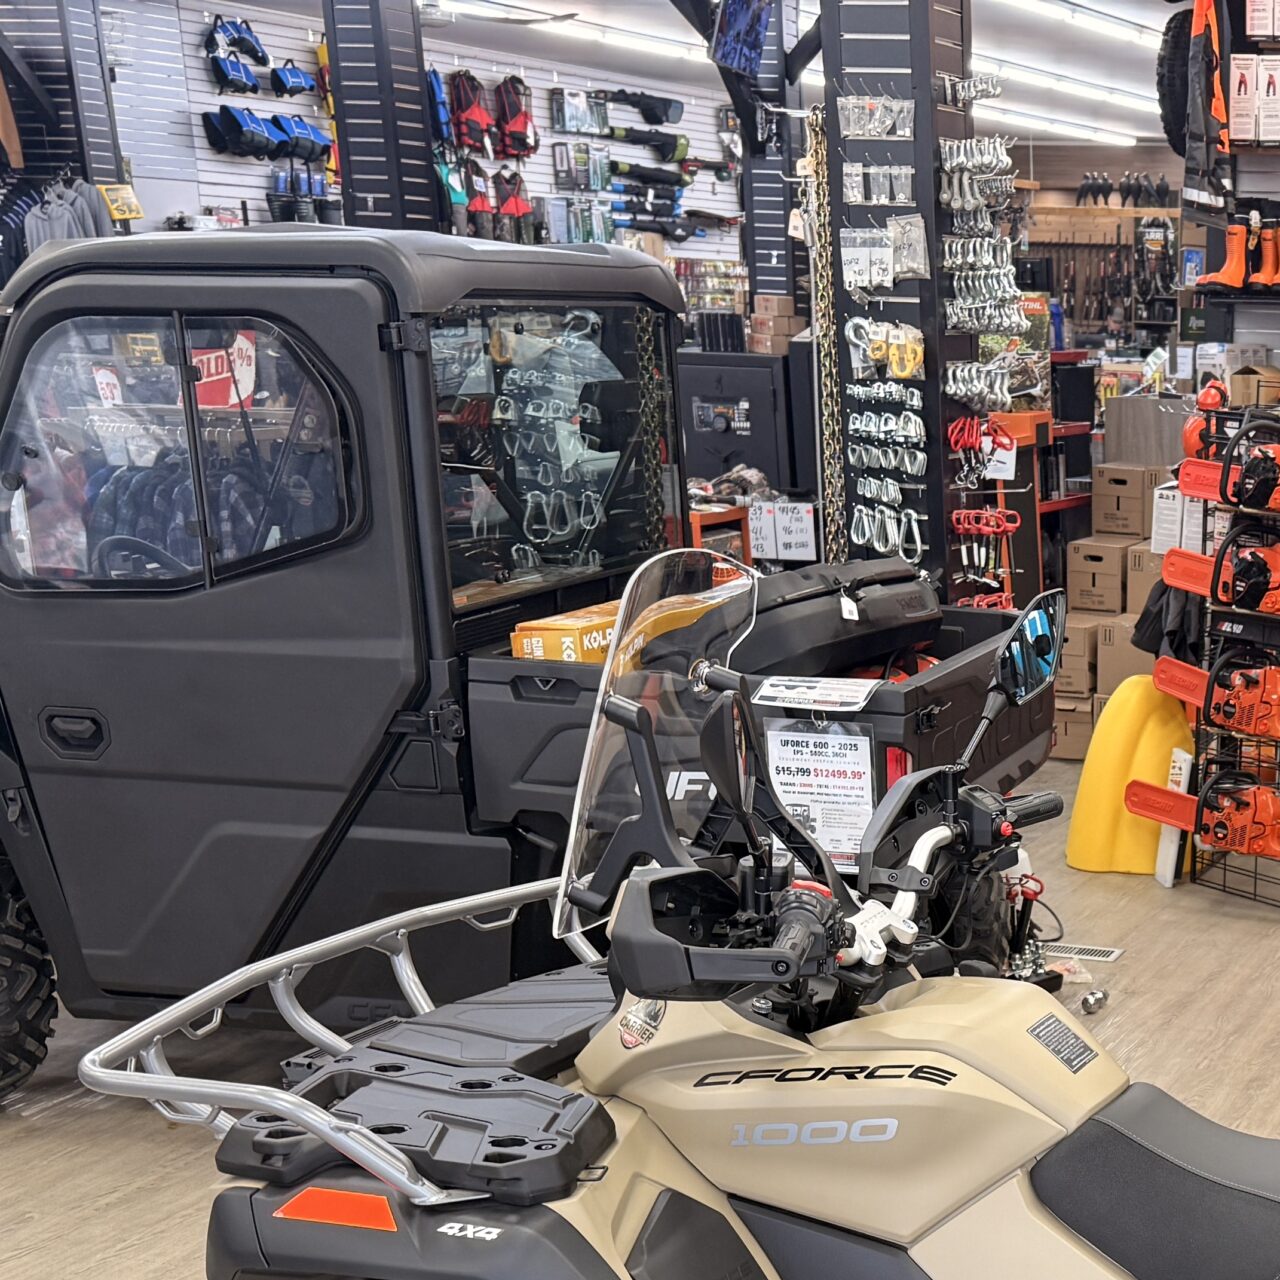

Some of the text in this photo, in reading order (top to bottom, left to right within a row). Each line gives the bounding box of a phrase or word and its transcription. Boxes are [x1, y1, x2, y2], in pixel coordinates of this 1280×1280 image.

[780, 739, 810, 748] UFORCE
[813, 741, 829, 750] 600
[838, 742, 859, 752] 2025
[775, 765, 811, 778] $15,799
[619, 1015, 656, 1044] CARRIER
[693, 1064, 958, 1088] CFORCE
[730, 1117, 899, 1147] 1000
